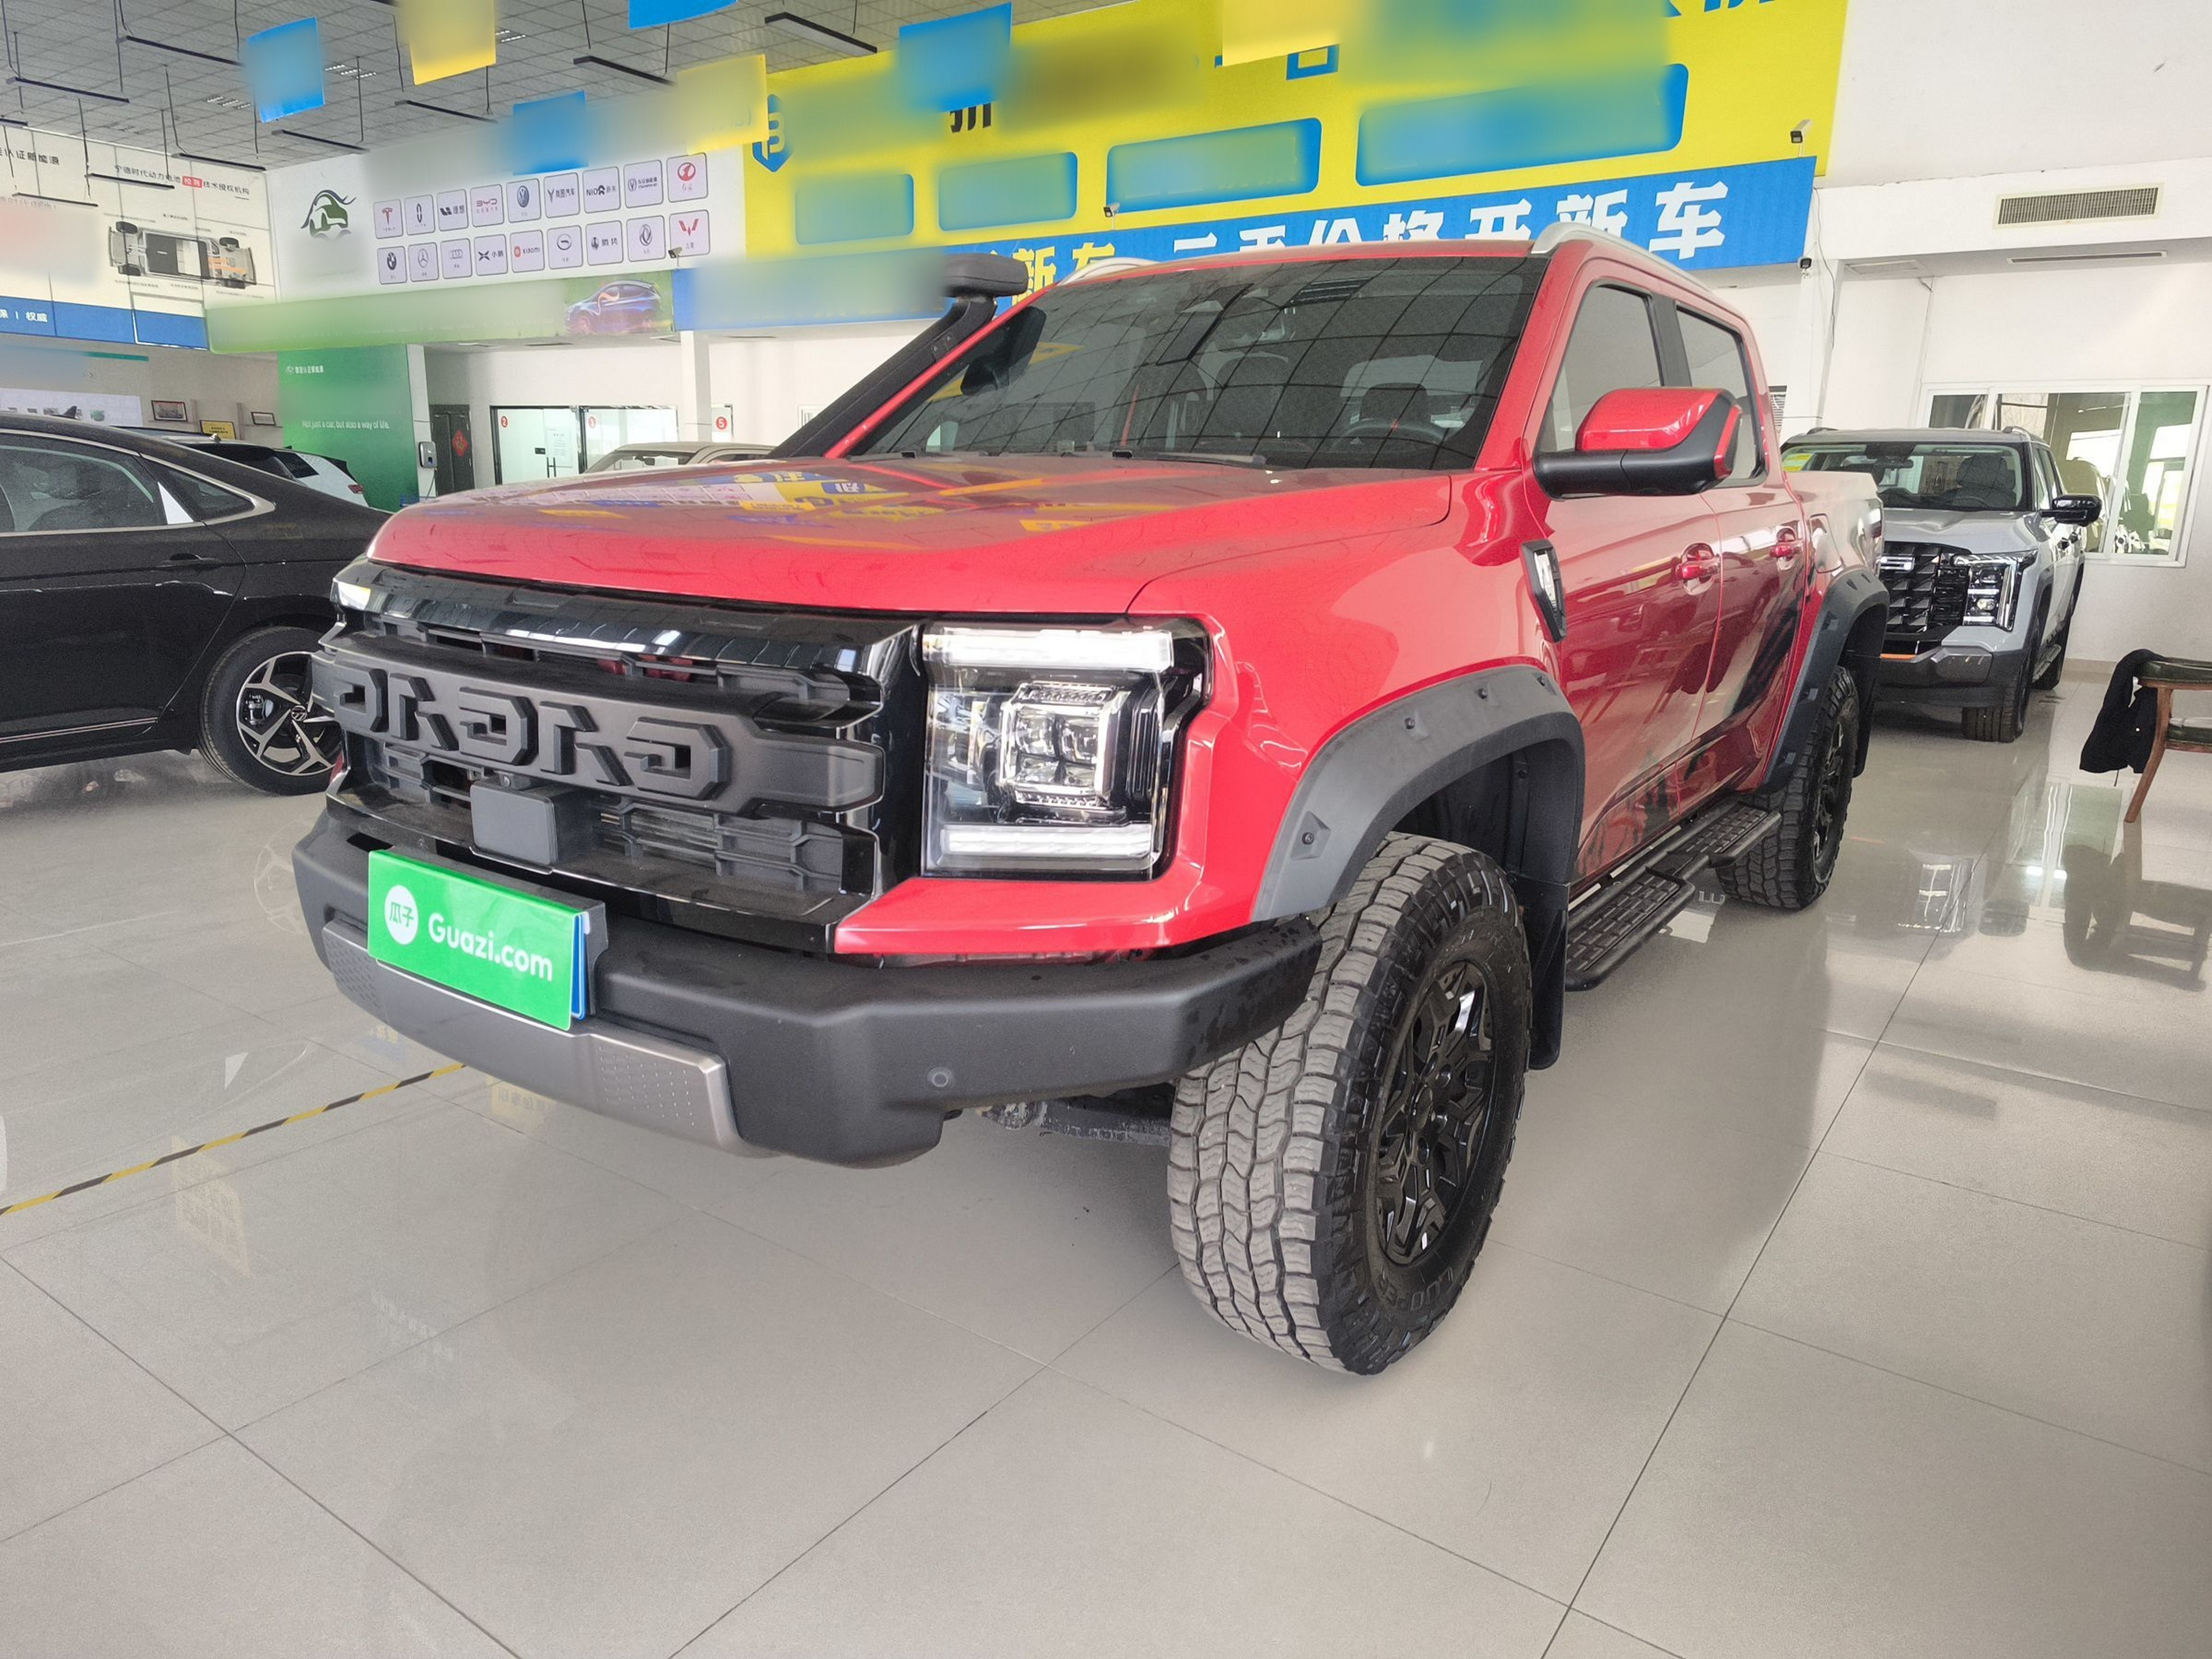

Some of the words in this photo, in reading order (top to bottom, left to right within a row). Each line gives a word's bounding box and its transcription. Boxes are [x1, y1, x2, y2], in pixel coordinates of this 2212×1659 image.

[476, 198, 498, 207] BYD
[389, 901, 414, 928] 瓜子
[428, 912, 553, 982] Guazi.com
